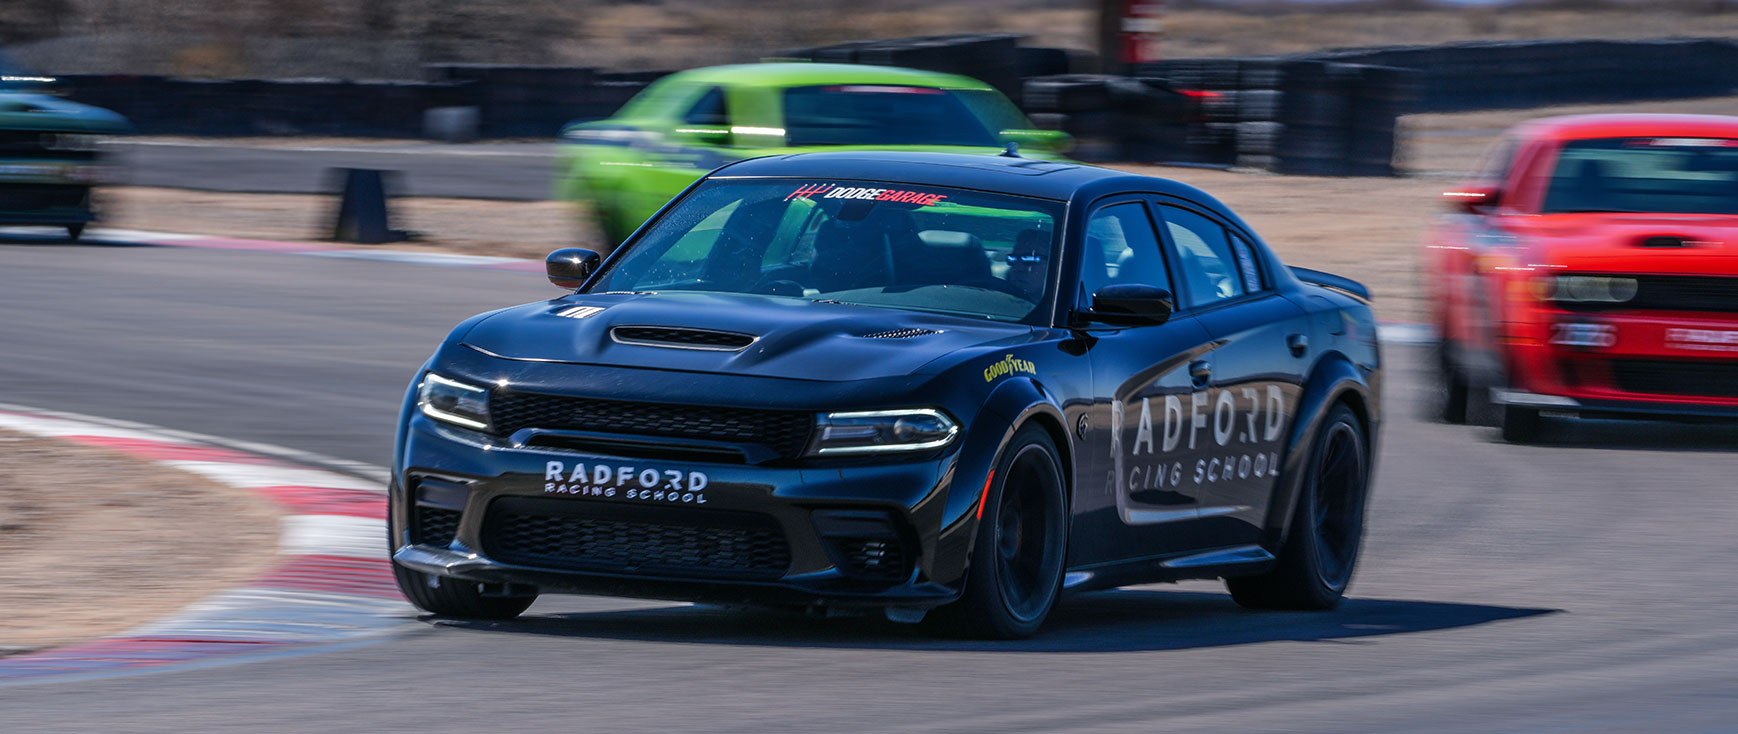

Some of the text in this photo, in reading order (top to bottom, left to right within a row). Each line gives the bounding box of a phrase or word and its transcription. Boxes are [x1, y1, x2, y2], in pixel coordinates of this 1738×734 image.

[1110, 384, 1285, 458] RADFORD
[544, 482, 707, 504] RACING SCHOOL
[545, 460, 708, 492] RADFORD
[1104, 452, 1280, 496] RCING SCHOOL
